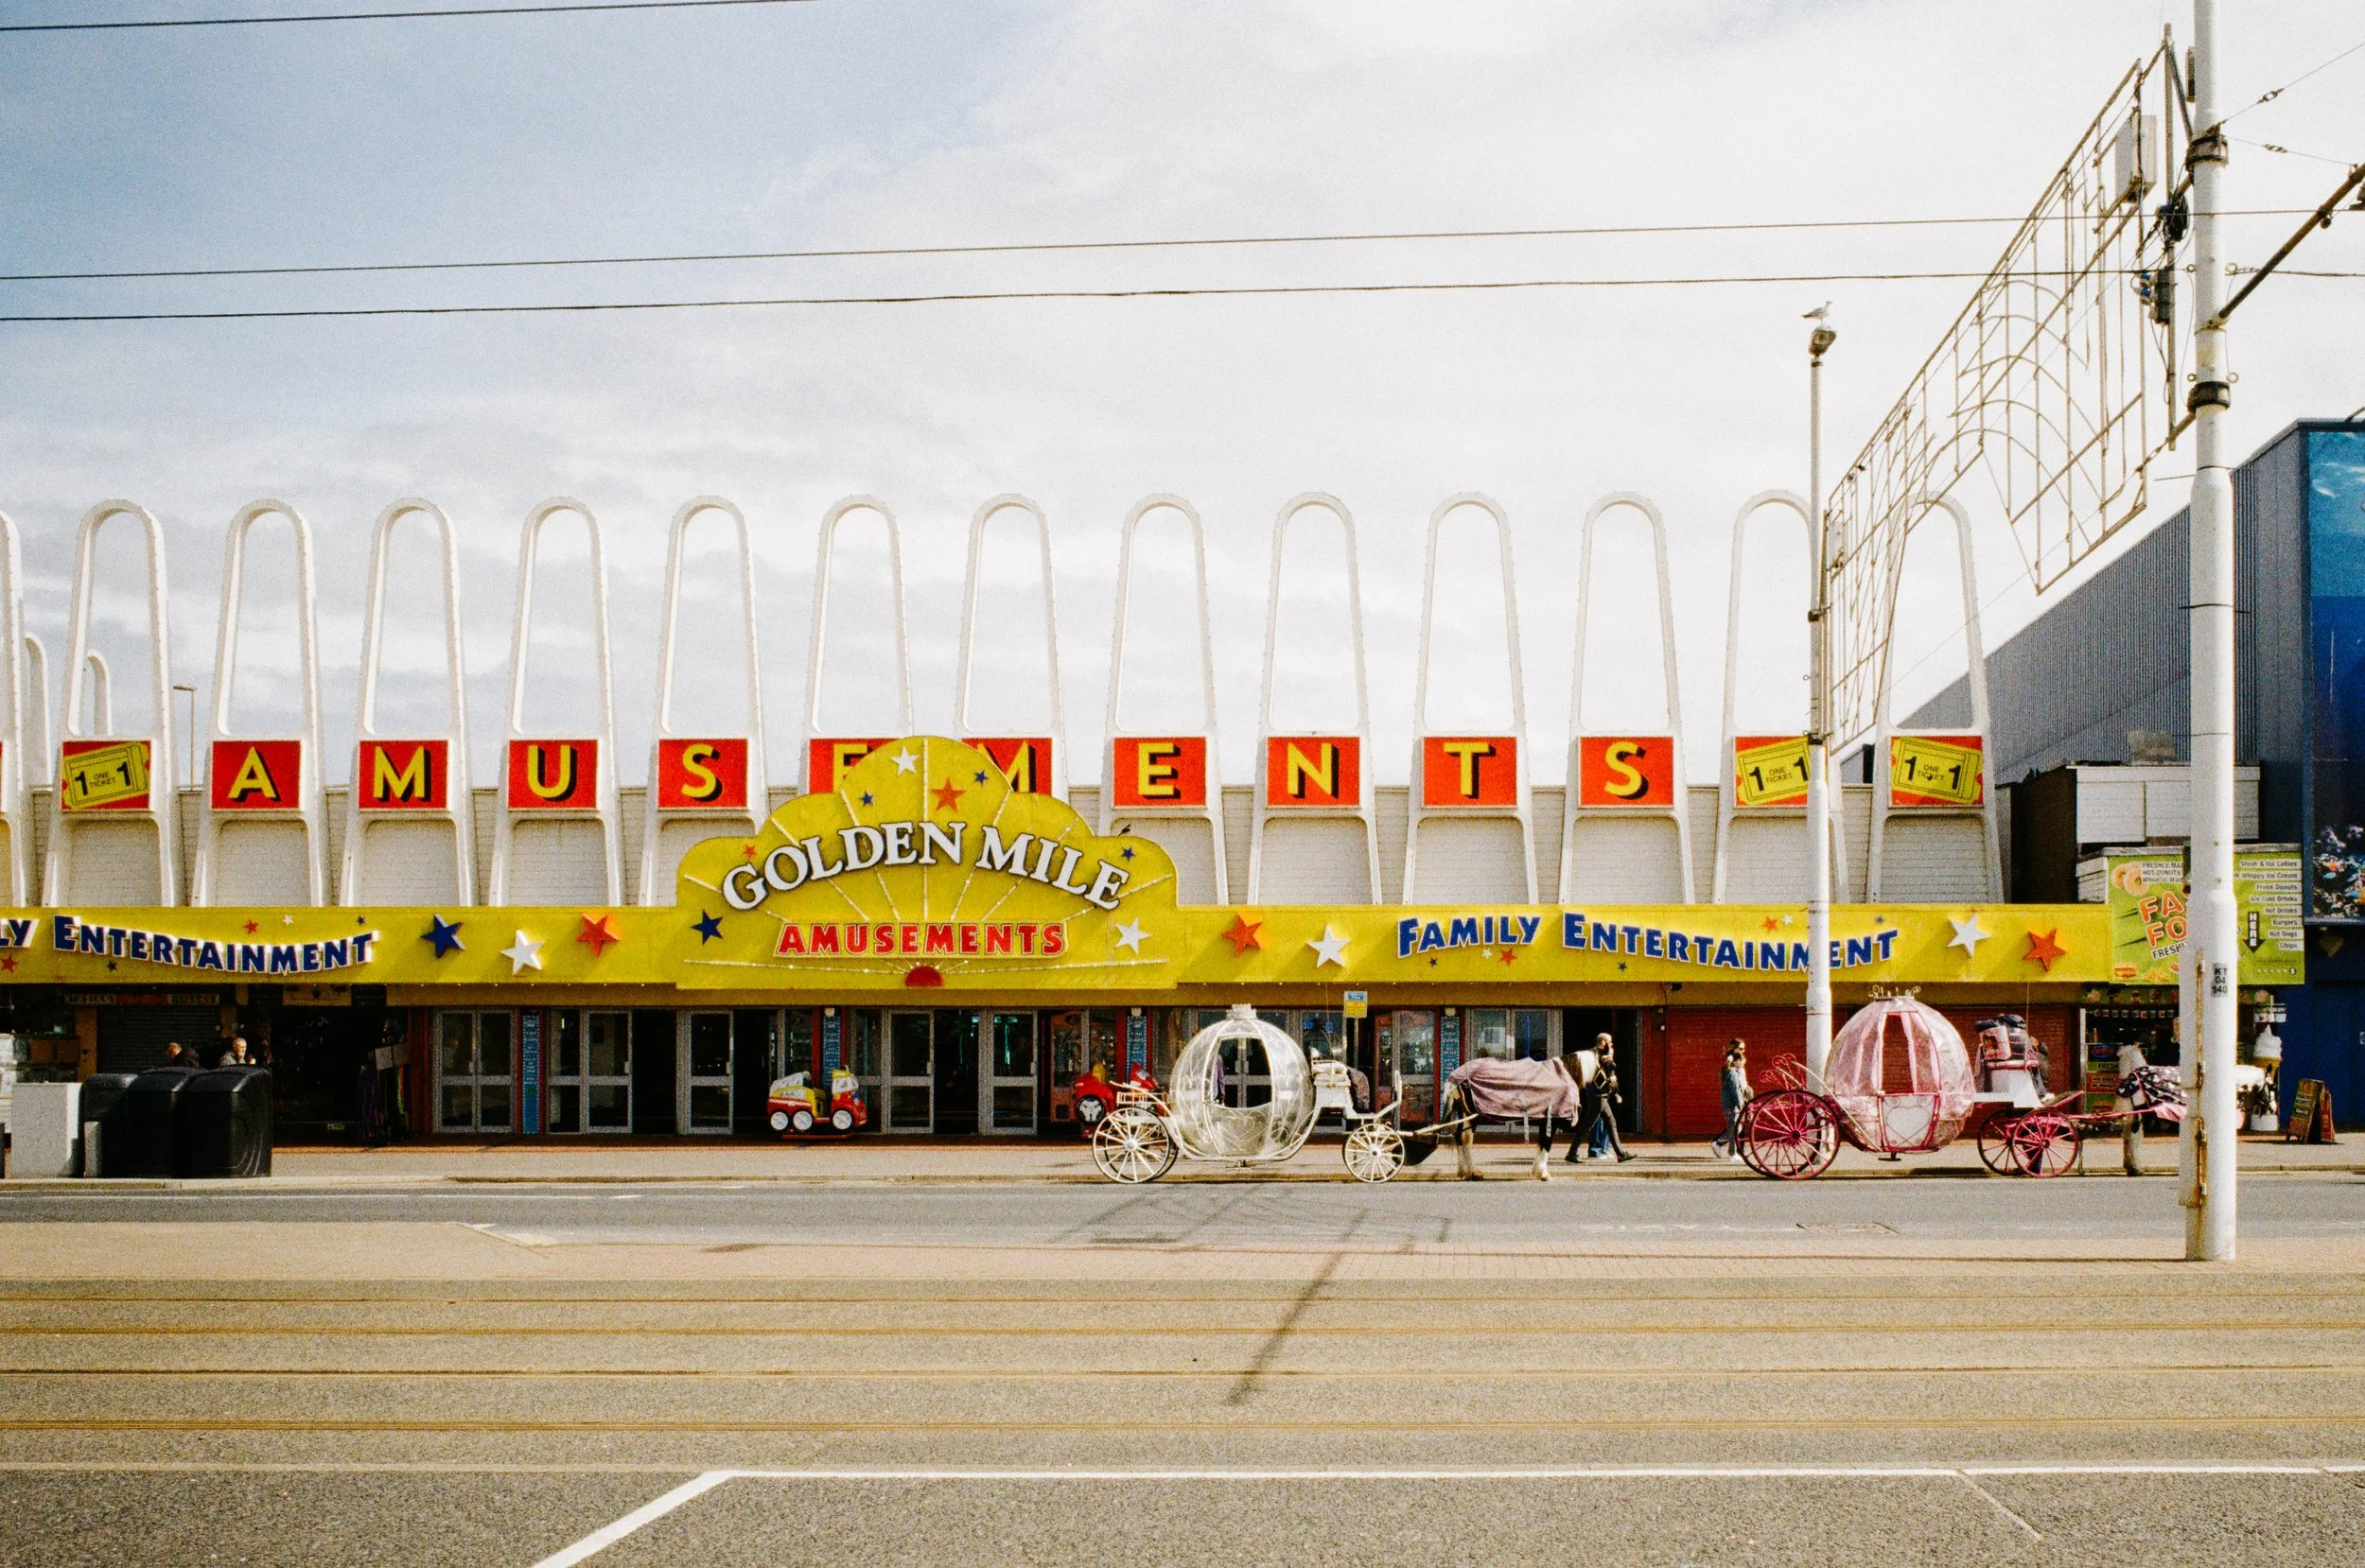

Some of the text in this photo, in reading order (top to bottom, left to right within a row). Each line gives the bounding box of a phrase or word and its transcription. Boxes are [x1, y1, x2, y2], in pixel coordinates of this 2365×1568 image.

[93, 772, 110, 780] ONE
[116, 761, 131, 787] 1
[1749, 766, 1764, 792] 1
[1764, 772, 1793, 785] TICKET
[1768, 766, 1786, 776] ONE
[1793, 757, 1809, 782] 1
[1904, 757, 1918, 781] 1
[1923, 764, 1939, 774] ONE
[1949, 764, 1962, 791] 1
[74, 771, 89, 796] 1
[89, 776, 115, 790] TICKET
[723, 821, 1130, 910] GOLDEN MILE
[53, 915, 379, 975] ENTERTAINMENT
[777, 923, 1065, 955] AMUSEMENTS
[1396, 915, 1542, 959] FAMILY
